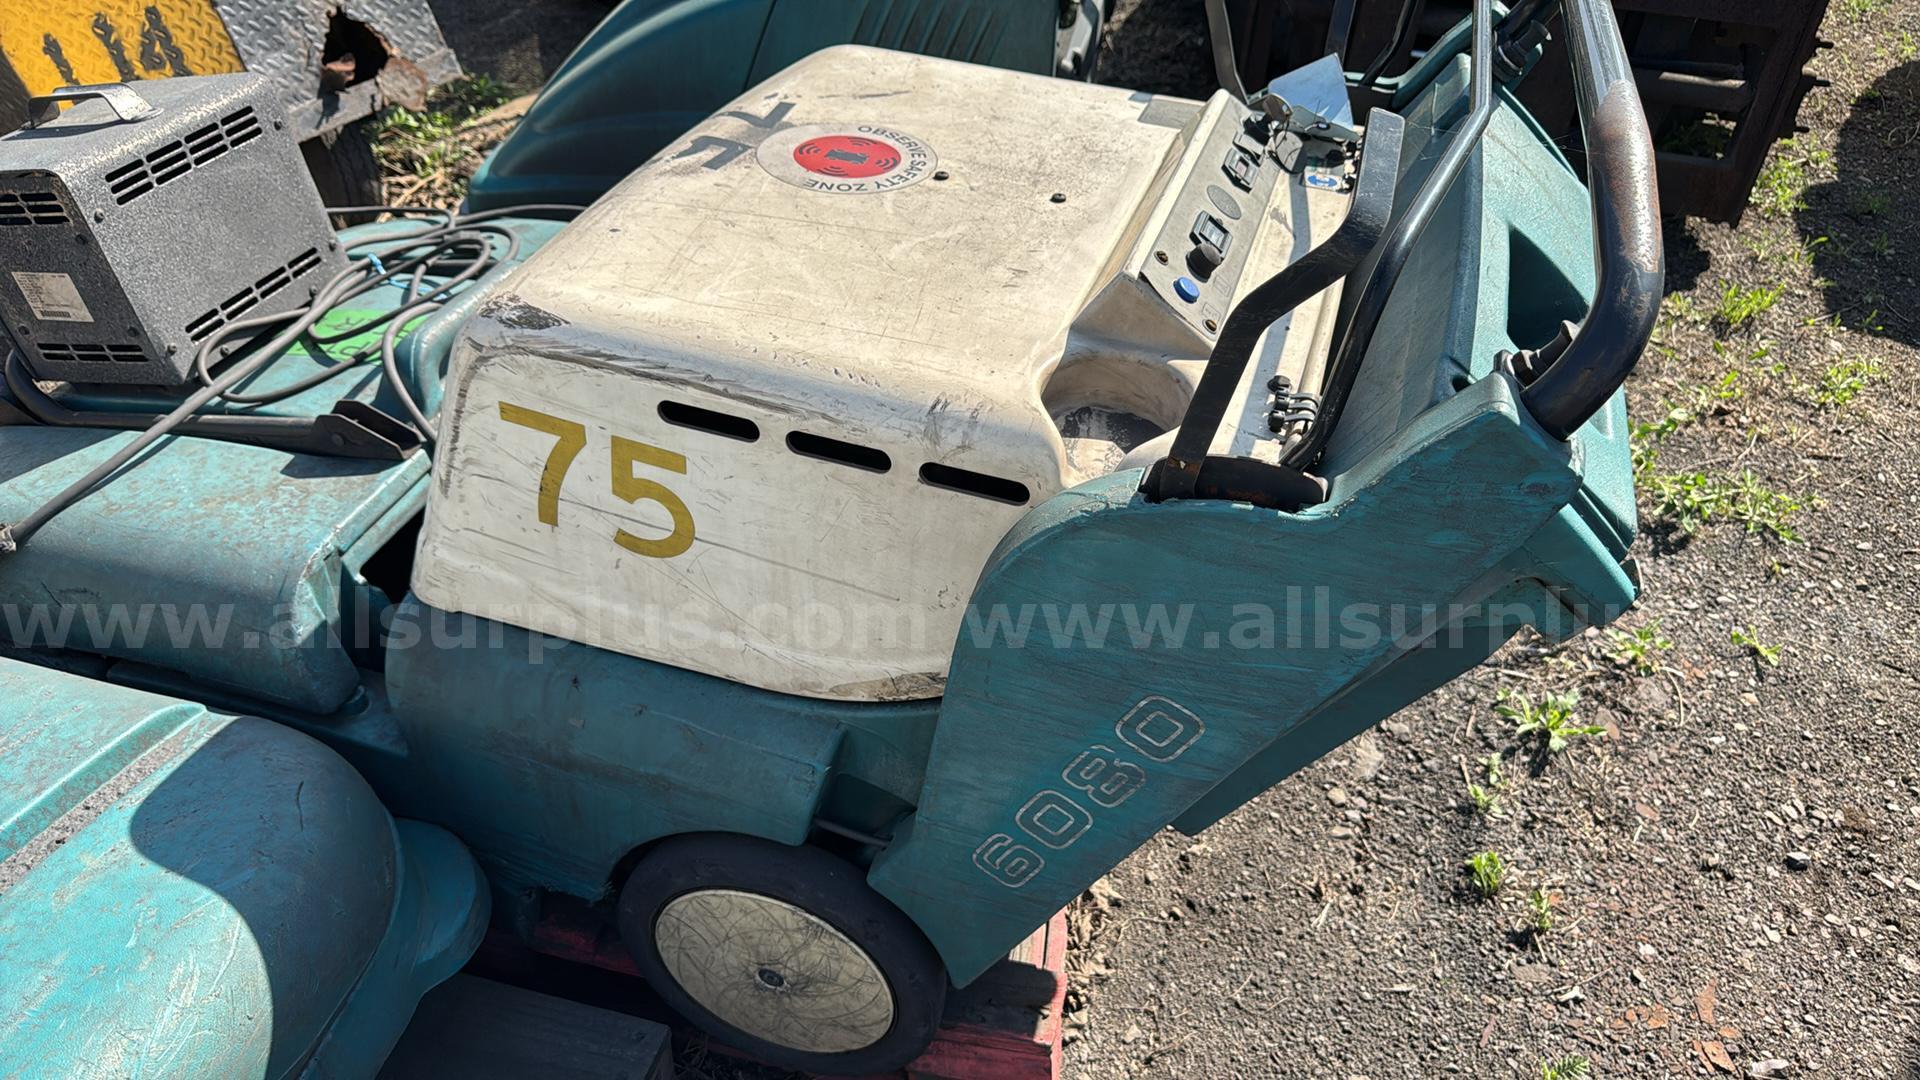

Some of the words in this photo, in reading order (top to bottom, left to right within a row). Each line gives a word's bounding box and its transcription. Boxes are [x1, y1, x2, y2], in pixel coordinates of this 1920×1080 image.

[858, 125, 927, 159] OBSERVE
[803, 179, 868, 192] ZONE
[875, 159, 927, 189] SAFETY
[498, 401, 696, 558] 75
[972, 695, 1206, 888] 6080
